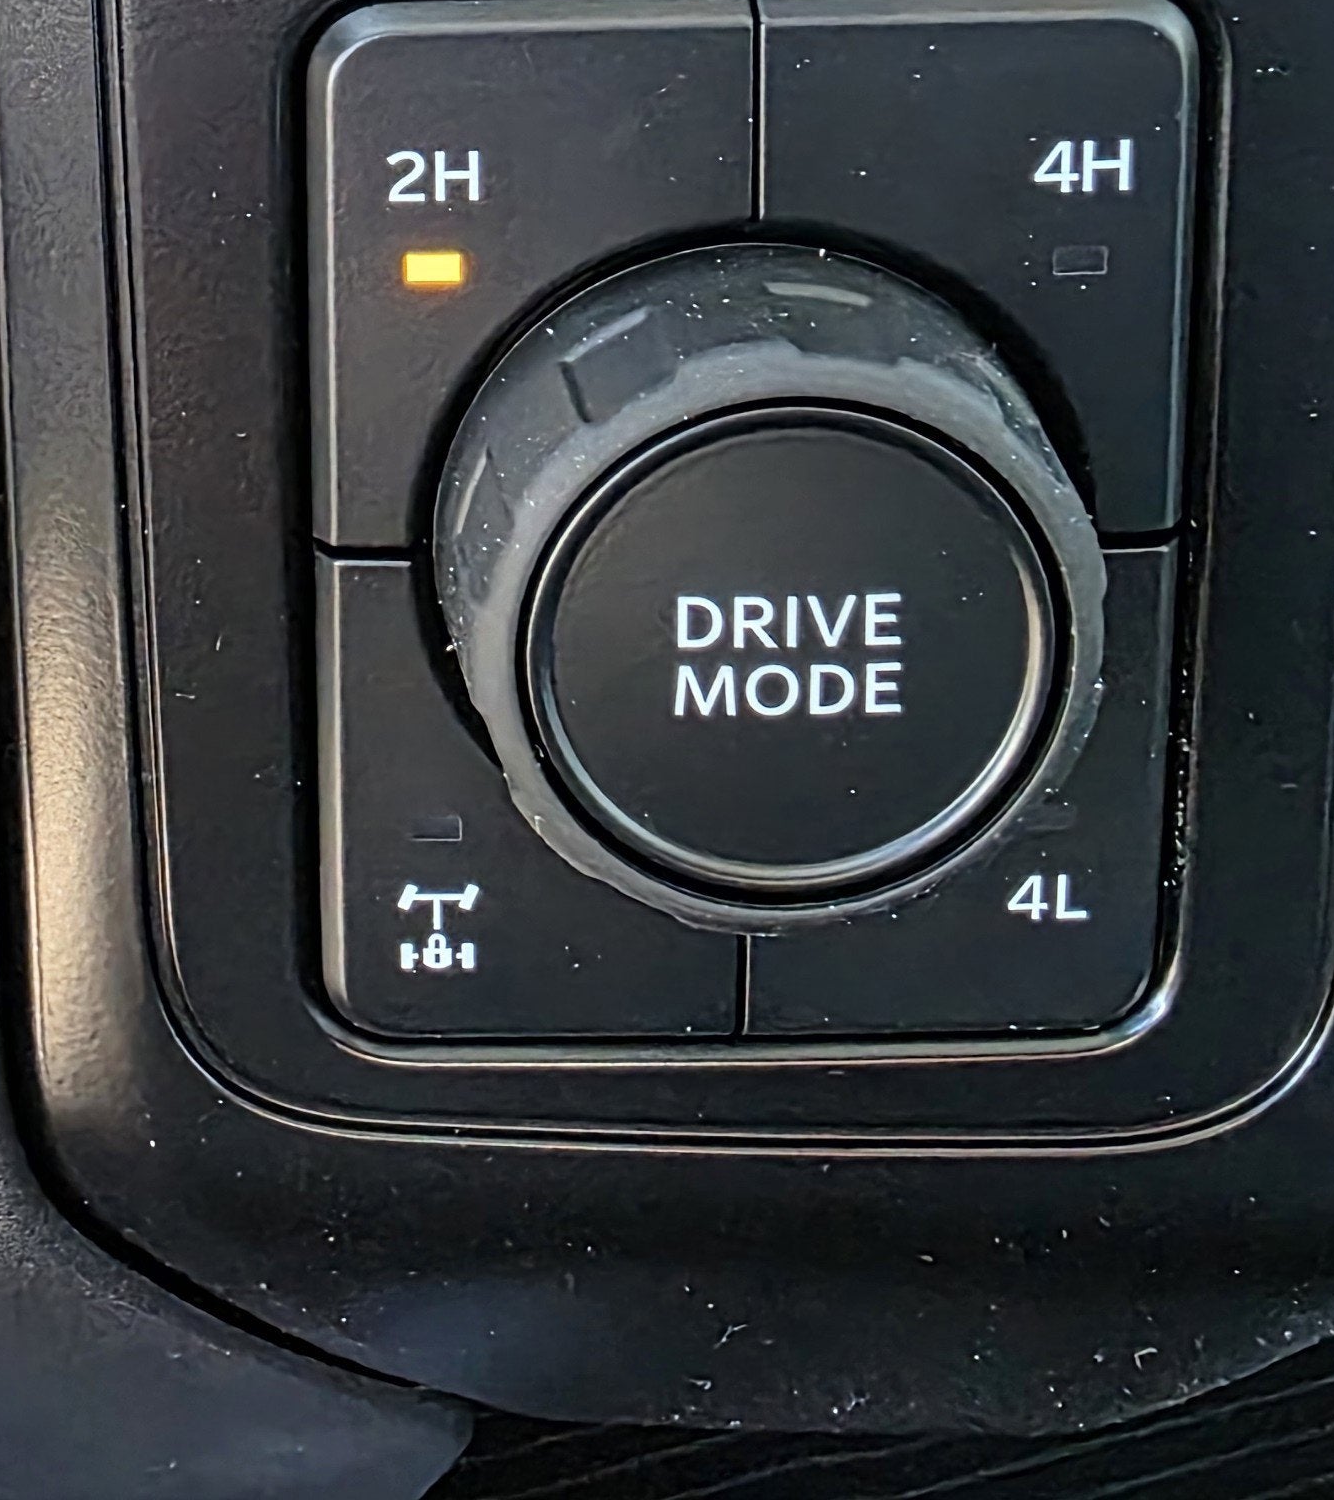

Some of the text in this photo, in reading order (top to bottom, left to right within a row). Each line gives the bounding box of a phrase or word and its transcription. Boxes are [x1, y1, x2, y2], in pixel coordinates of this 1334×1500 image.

[384, 149, 482, 204] 2H
[1031, 138, 1134, 194] 4H
[674, 592, 903, 650] DRIVE
[673, 661, 903, 717] MODE
[1006, 873, 1089, 921] 4L
